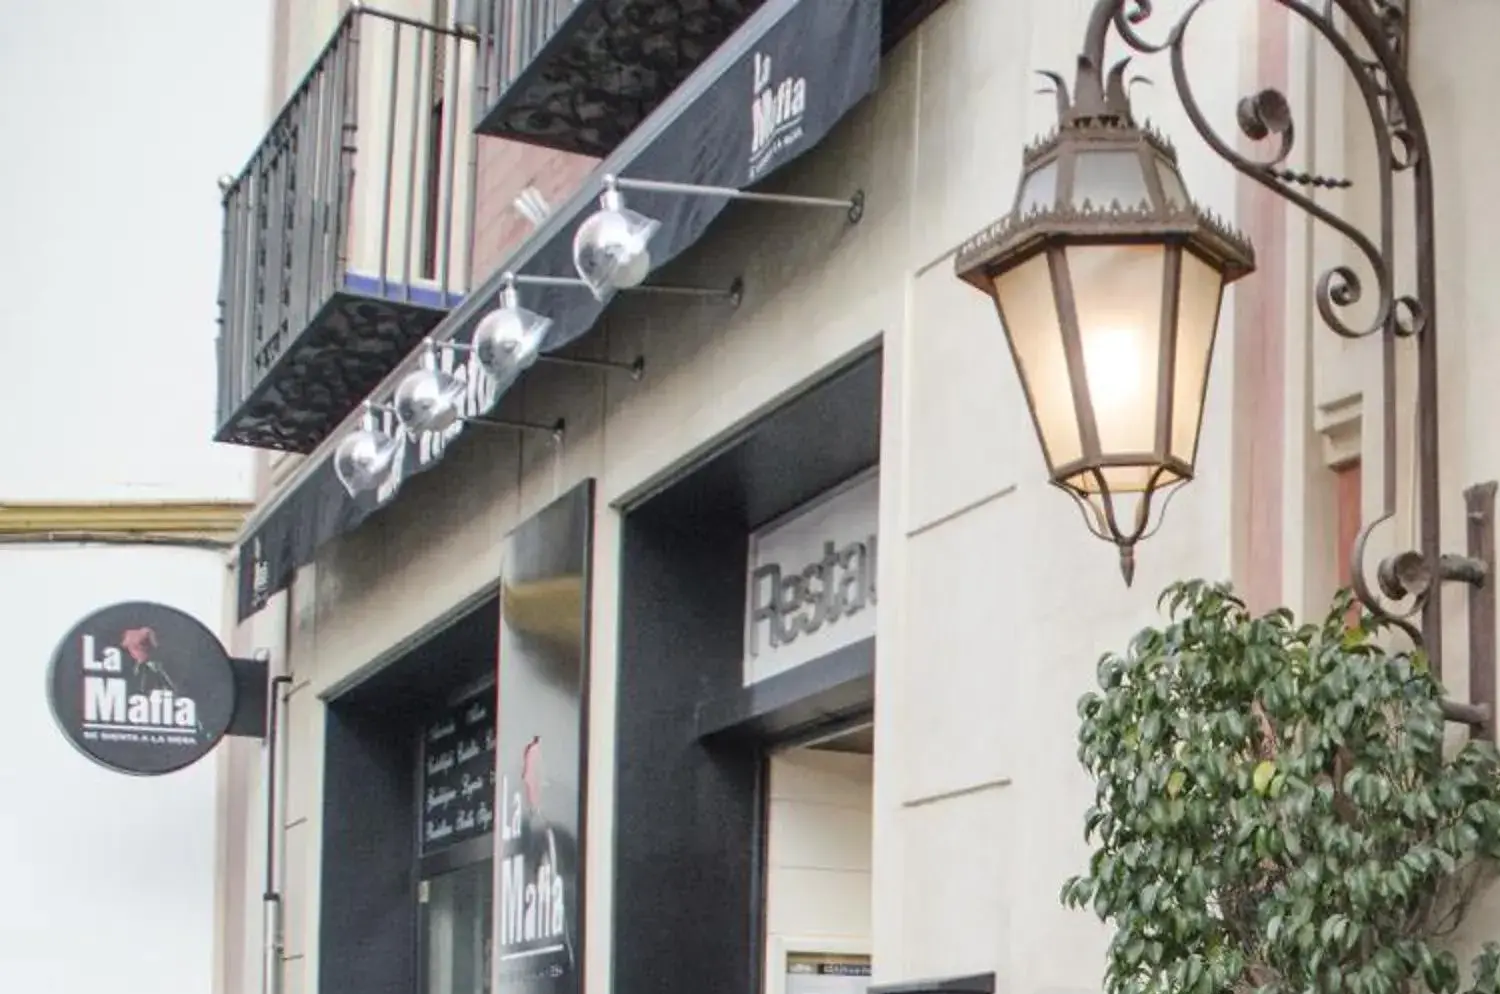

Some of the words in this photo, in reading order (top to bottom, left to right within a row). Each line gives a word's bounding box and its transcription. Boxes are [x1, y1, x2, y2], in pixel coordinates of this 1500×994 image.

[82, 634, 123, 672] La
[83, 675, 197, 728] Mafia
[502, 774, 522, 841] La
[501, 850, 564, 946] Mafia
